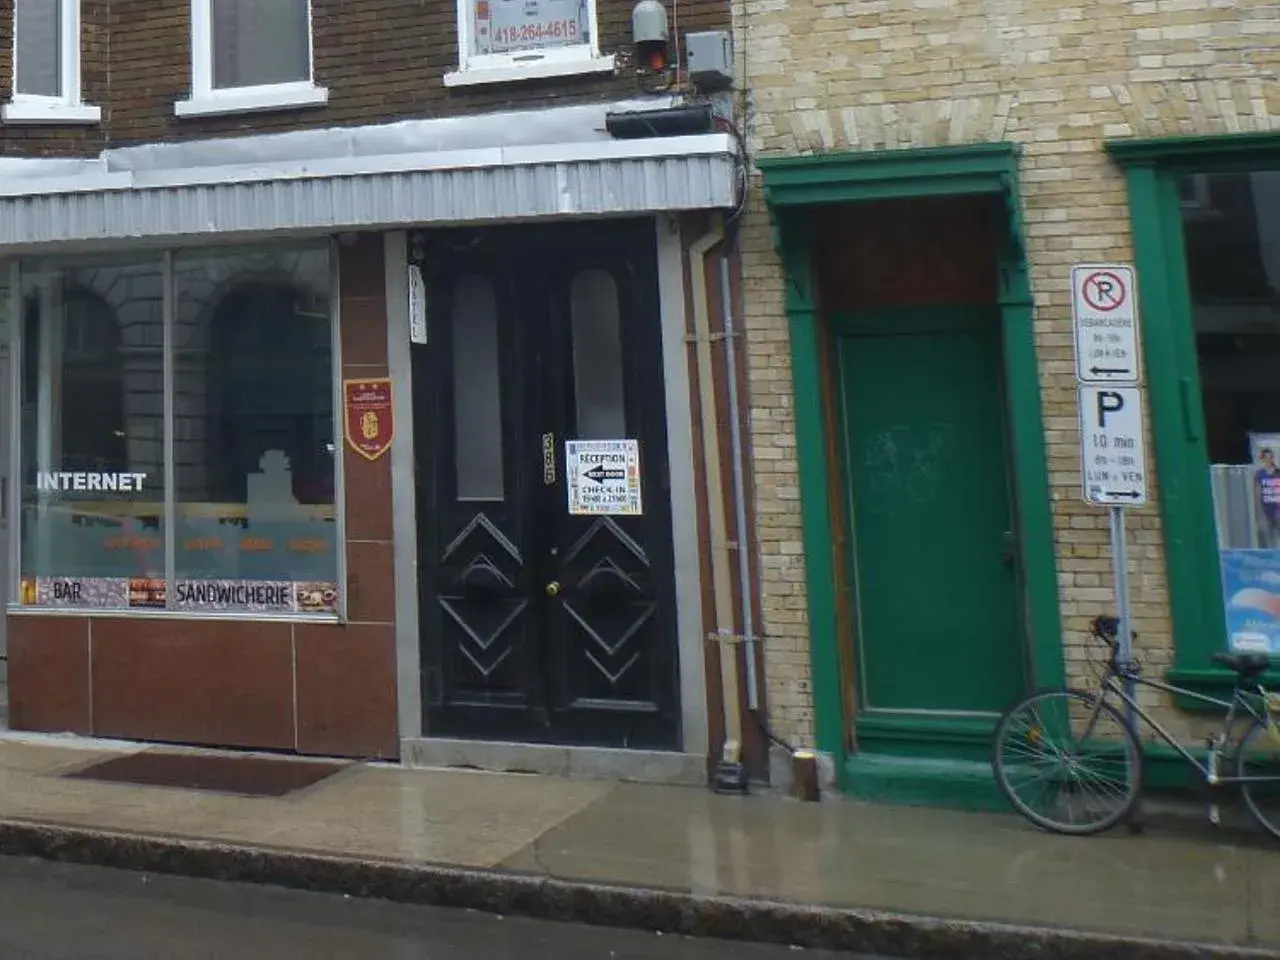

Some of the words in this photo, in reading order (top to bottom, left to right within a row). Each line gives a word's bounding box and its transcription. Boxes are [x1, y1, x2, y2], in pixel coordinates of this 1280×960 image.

[1097, 391, 1124, 428] P
[1113, 433, 1135, 449] min
[36, 472, 146, 492] INTERNET
[53, 581, 82, 600] BAR
[177, 583, 290, 607] SANDWICHERIE
